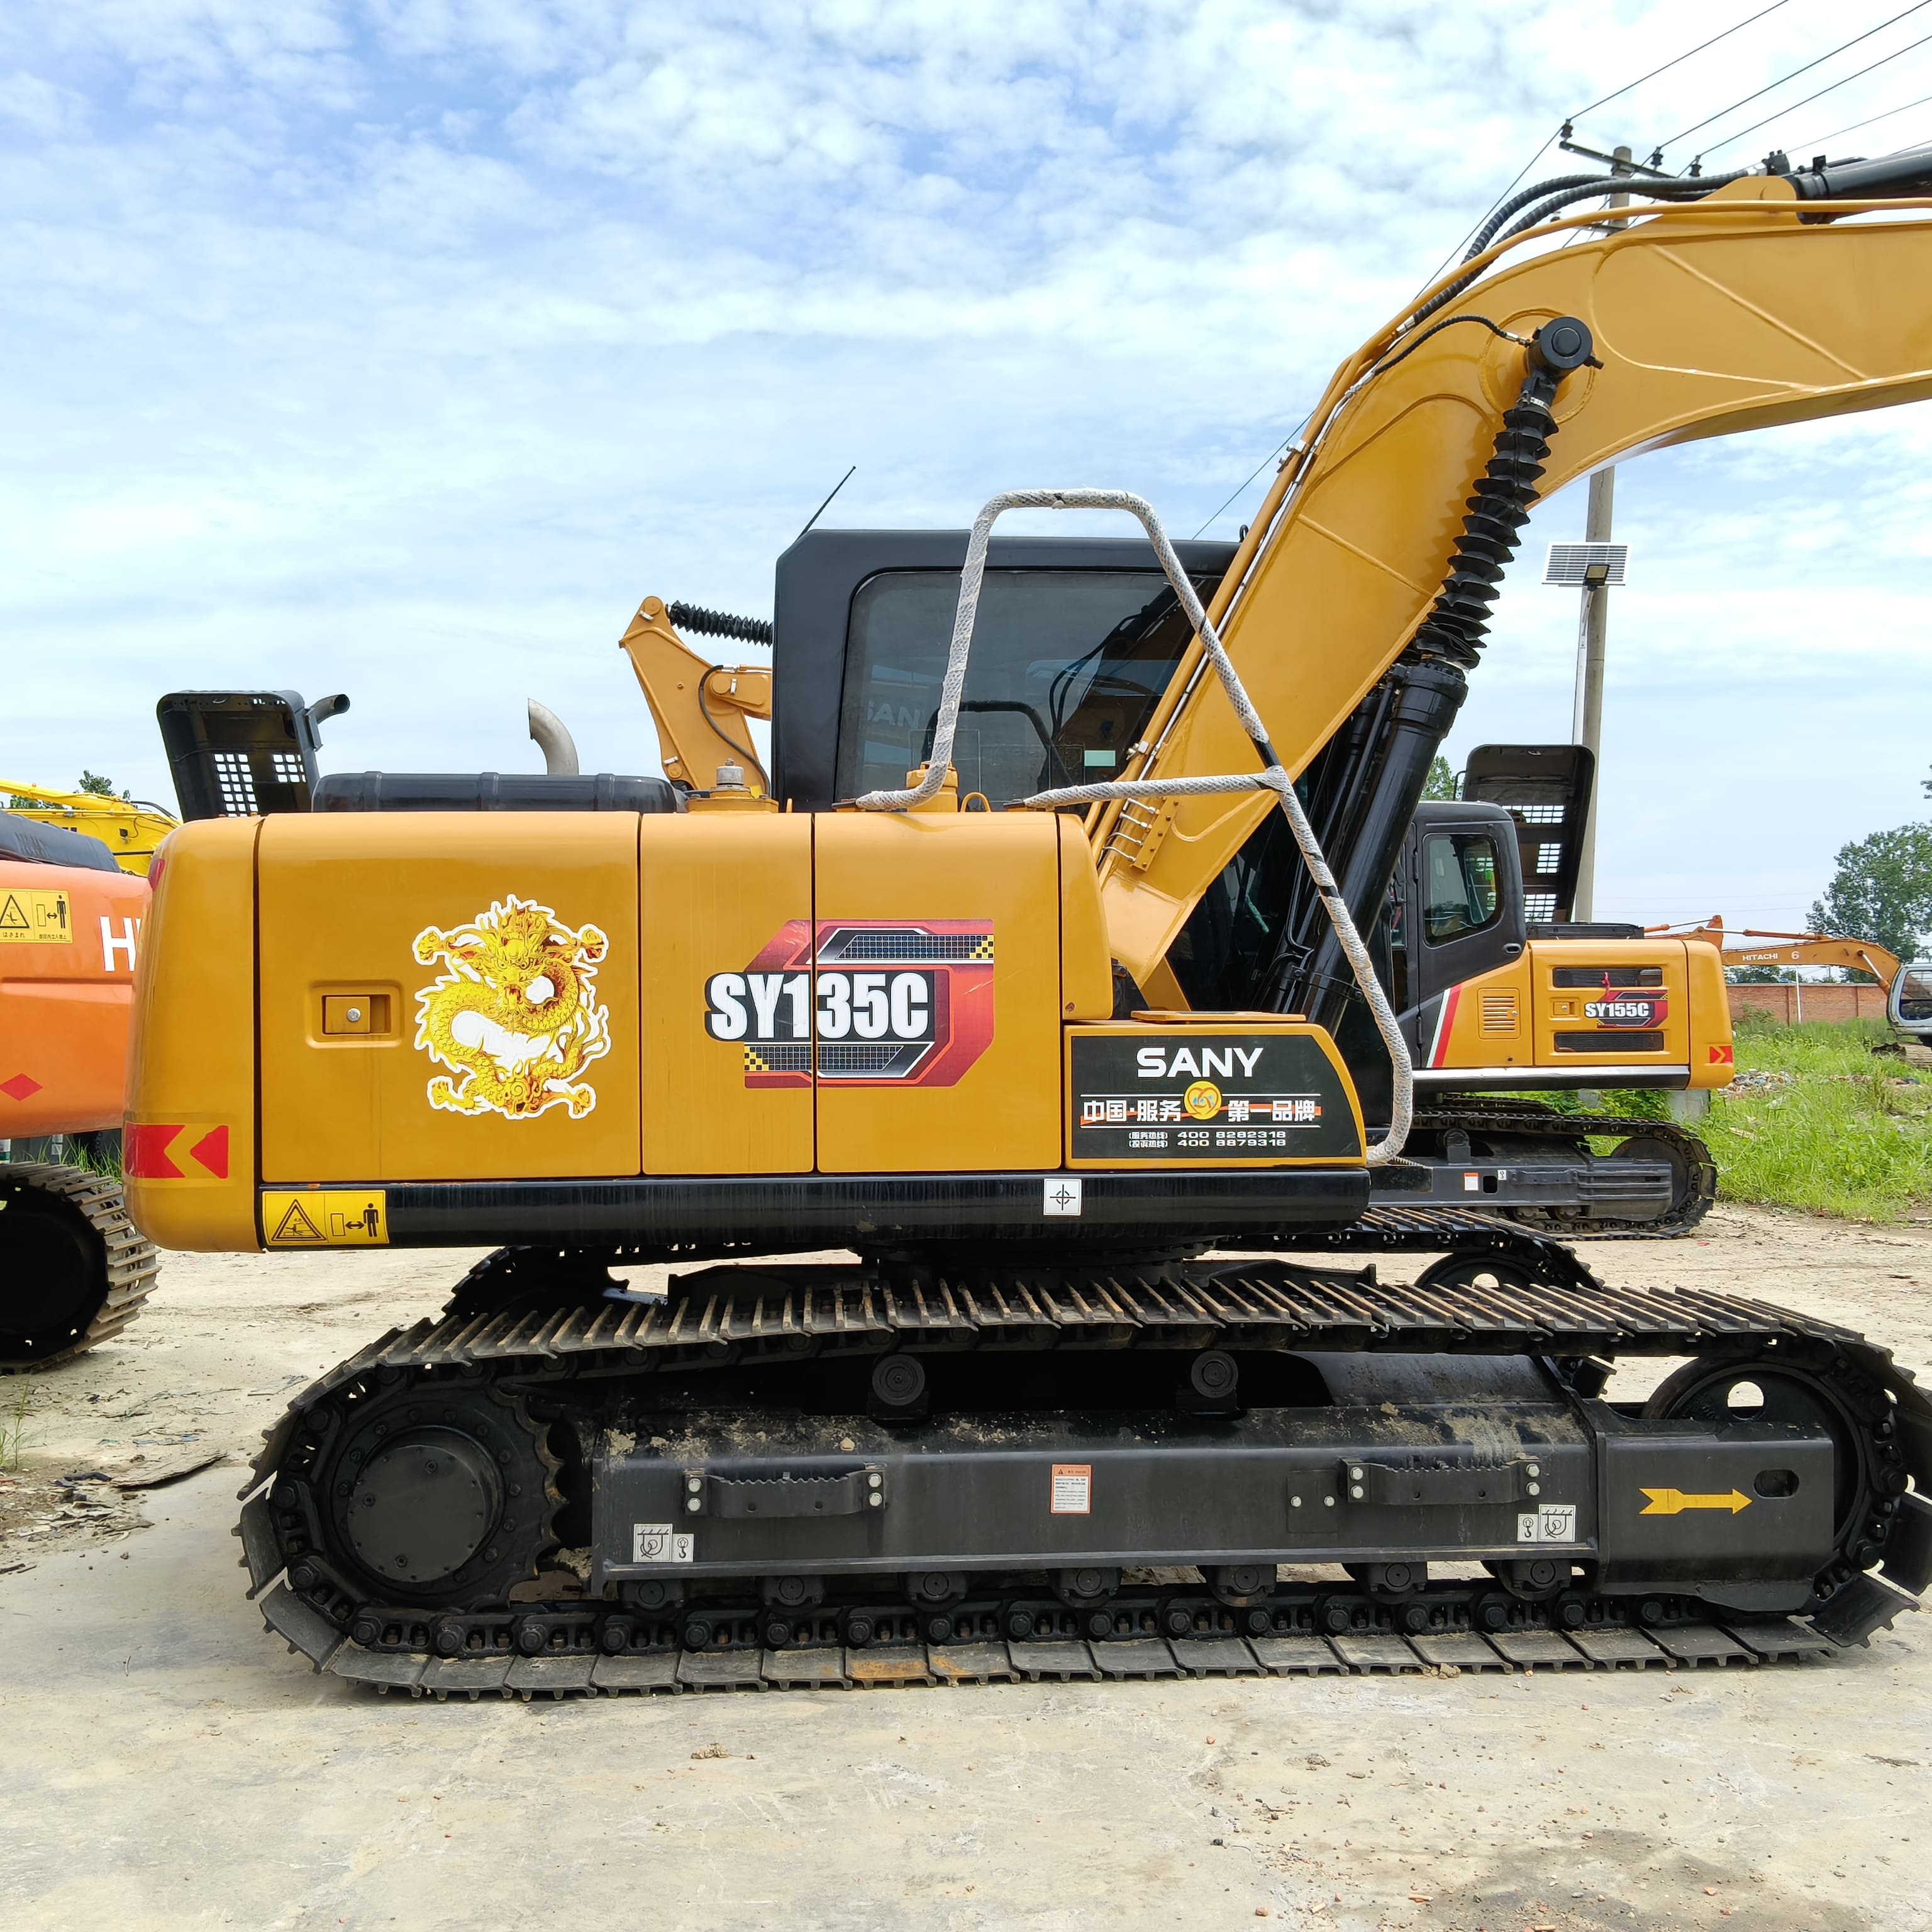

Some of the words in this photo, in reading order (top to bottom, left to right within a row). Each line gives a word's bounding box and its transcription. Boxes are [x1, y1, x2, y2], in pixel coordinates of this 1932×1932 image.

[99, 916, 142, 972] H
[1742, 953, 1779, 961] HITACHI
[1791, 951, 1799, 960] 6
[710, 972, 929, 1040] SY135C
[1585, 1002, 1649, 1018] SY155C
[1136, 1047, 1263, 1078] SANY
[1228, 1099, 1316, 1122] 第一品牌
